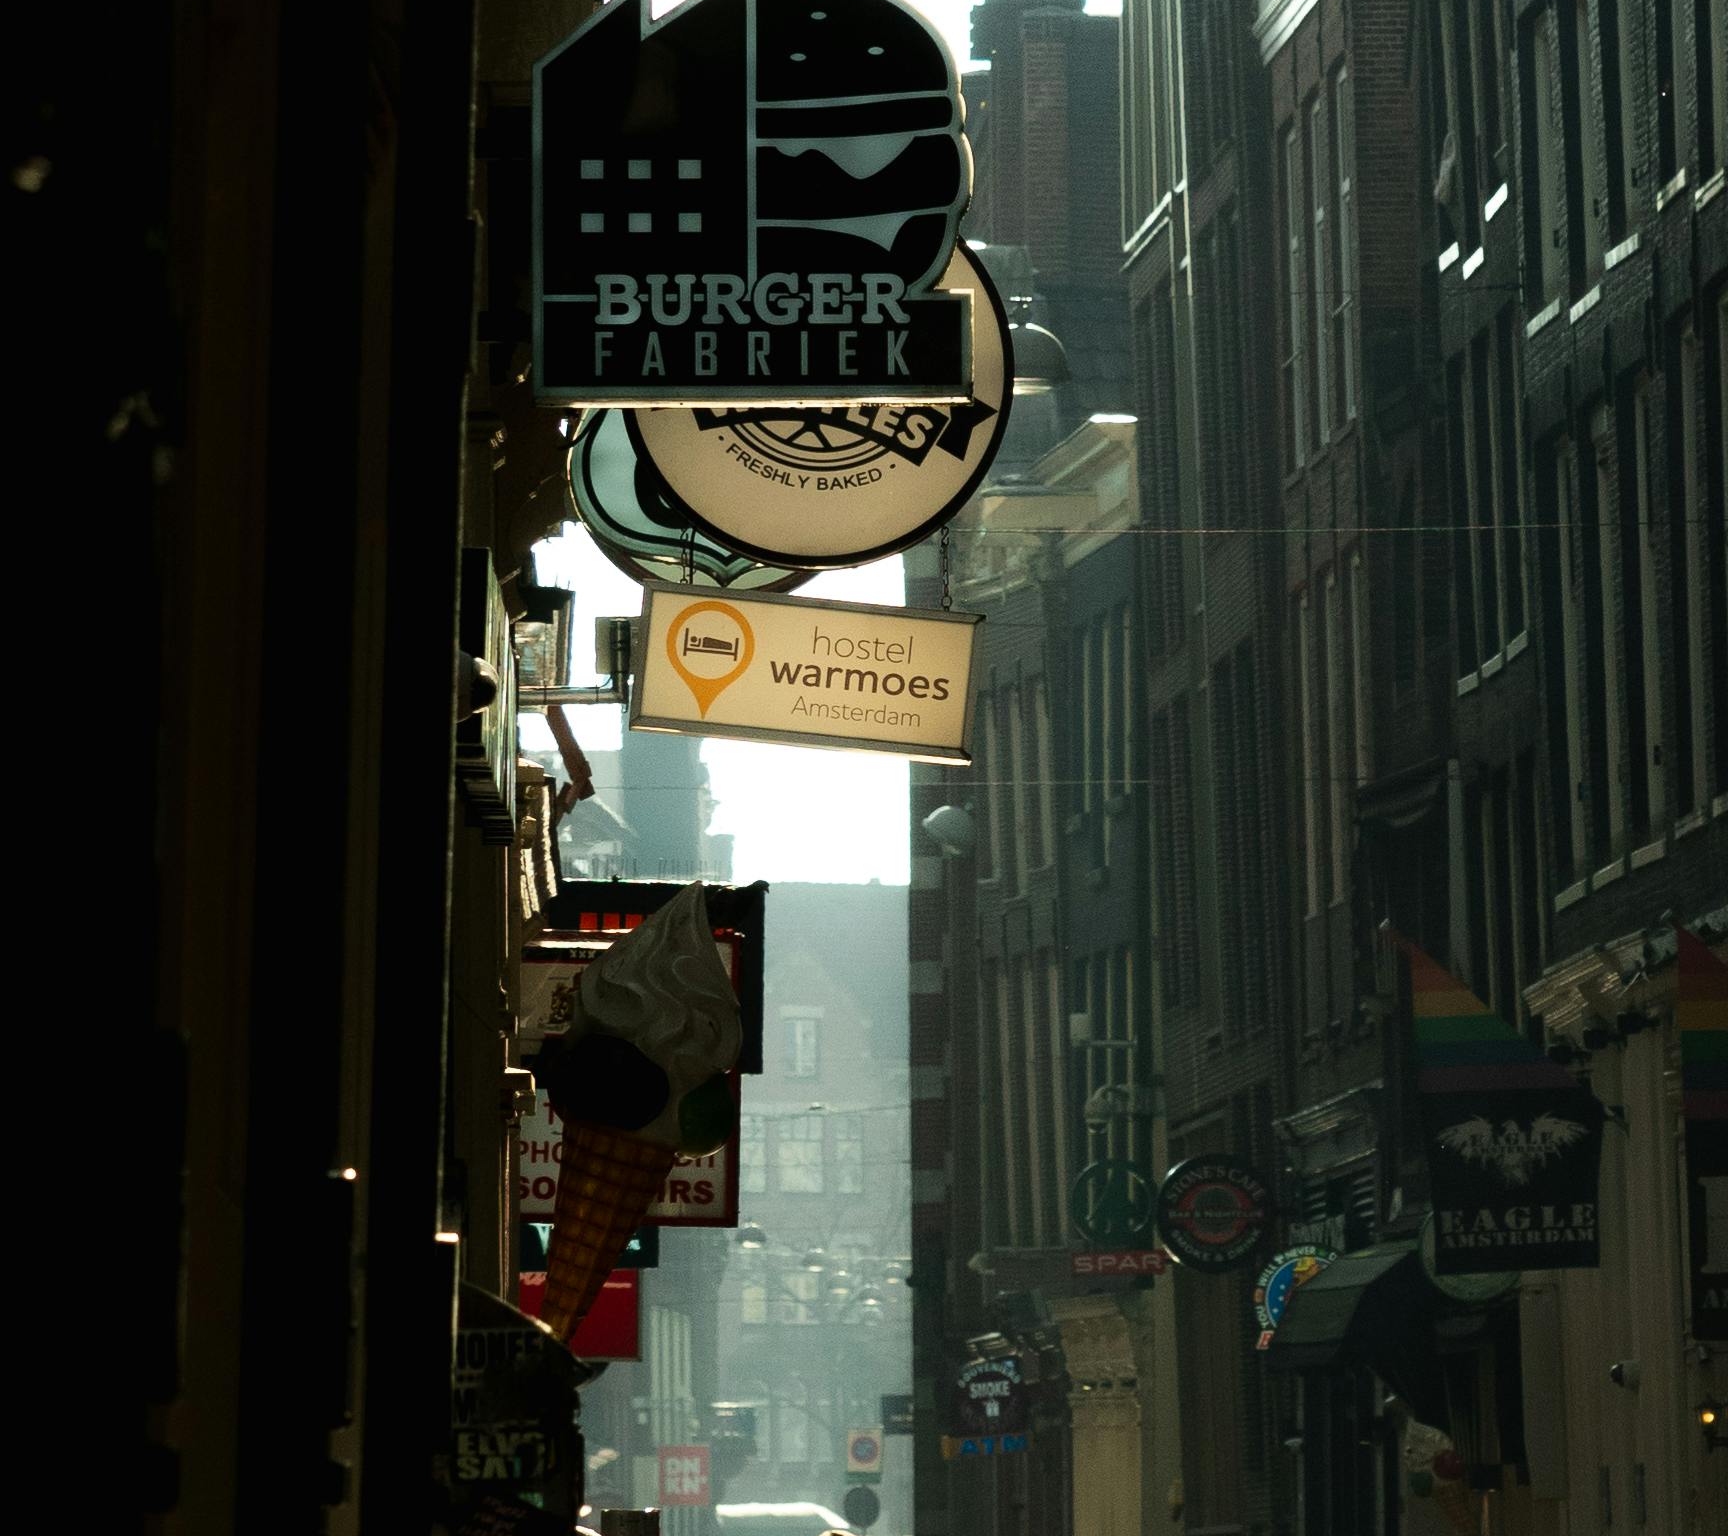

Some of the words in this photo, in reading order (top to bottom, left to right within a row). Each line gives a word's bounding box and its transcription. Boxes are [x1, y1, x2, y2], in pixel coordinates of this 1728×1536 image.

[594, 272, 911, 326] BURGER
[594, 330, 911, 377] FABRIEK
[726, 441, 811, 490] FRESHLY
[816, 466, 883, 491] BAKED
[812, 626, 915, 665] hostel
[769, 659, 950, 701] warmoes
[790, 694, 922, 728] Amsterdam
[1441, 1203, 1596, 1234] EAGLE
[1441, 1227, 1595, 1249] AMSTERDAM
[1074, 1253, 1164, 1275] SPAR
[1284, 1245, 1316, 1260] NEVER
[1257, 1263, 1278, 1287] WILL
[1253, 1305, 1270, 1329] YOU
[968, 1380, 1011, 1400] SMOKE
[960, 1433, 1028, 1456] ATM
